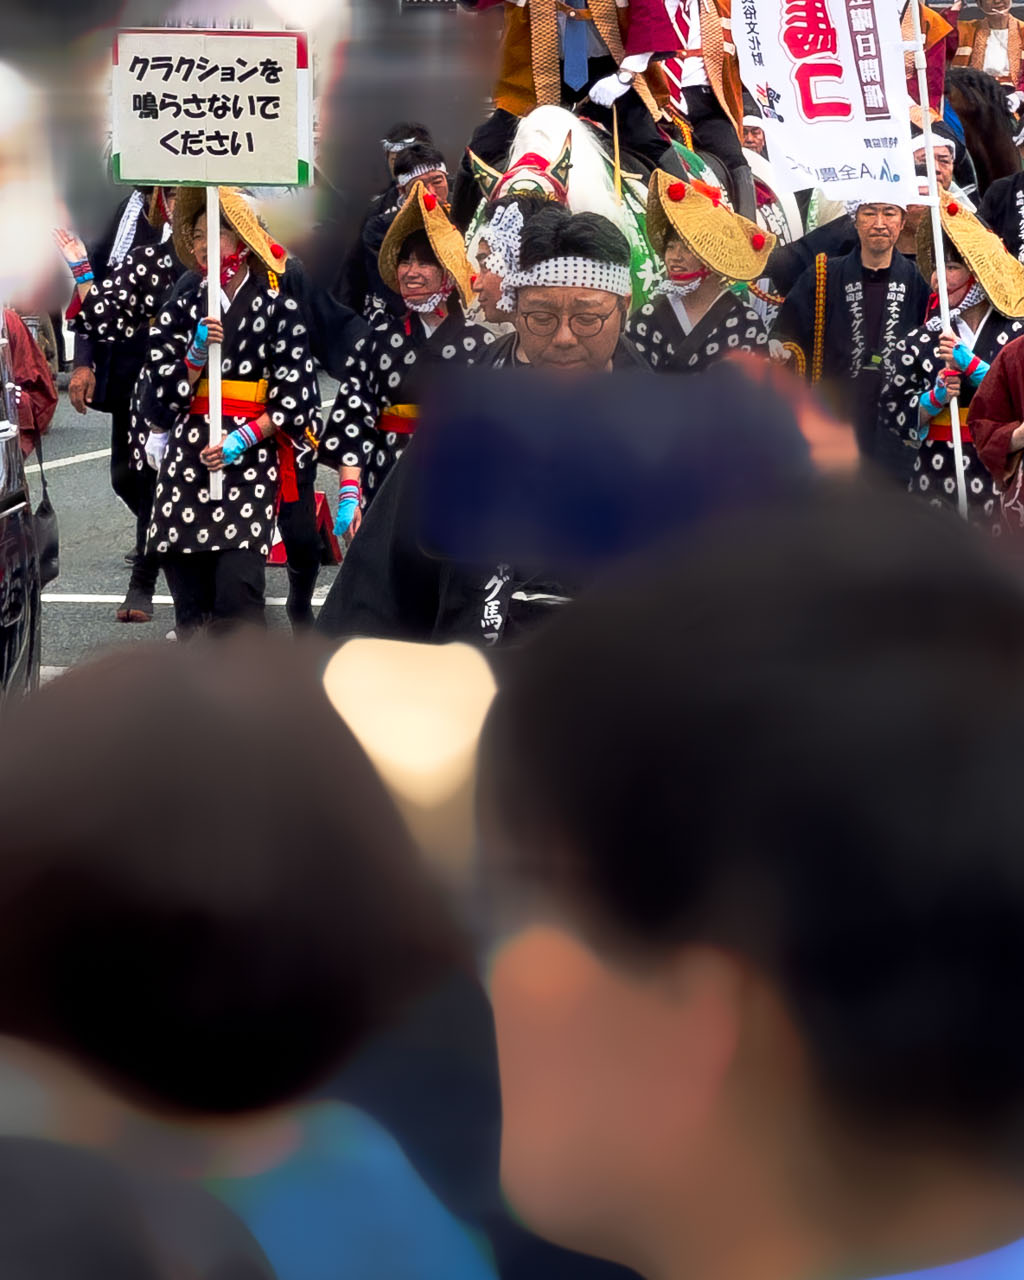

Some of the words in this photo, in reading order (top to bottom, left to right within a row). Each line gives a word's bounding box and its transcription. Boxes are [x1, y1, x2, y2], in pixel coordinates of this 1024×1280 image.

[128, 55, 284, 84] クラクションを
[132, 91, 281, 120] 鳴らさないで
[159, 129, 255, 156] ください
